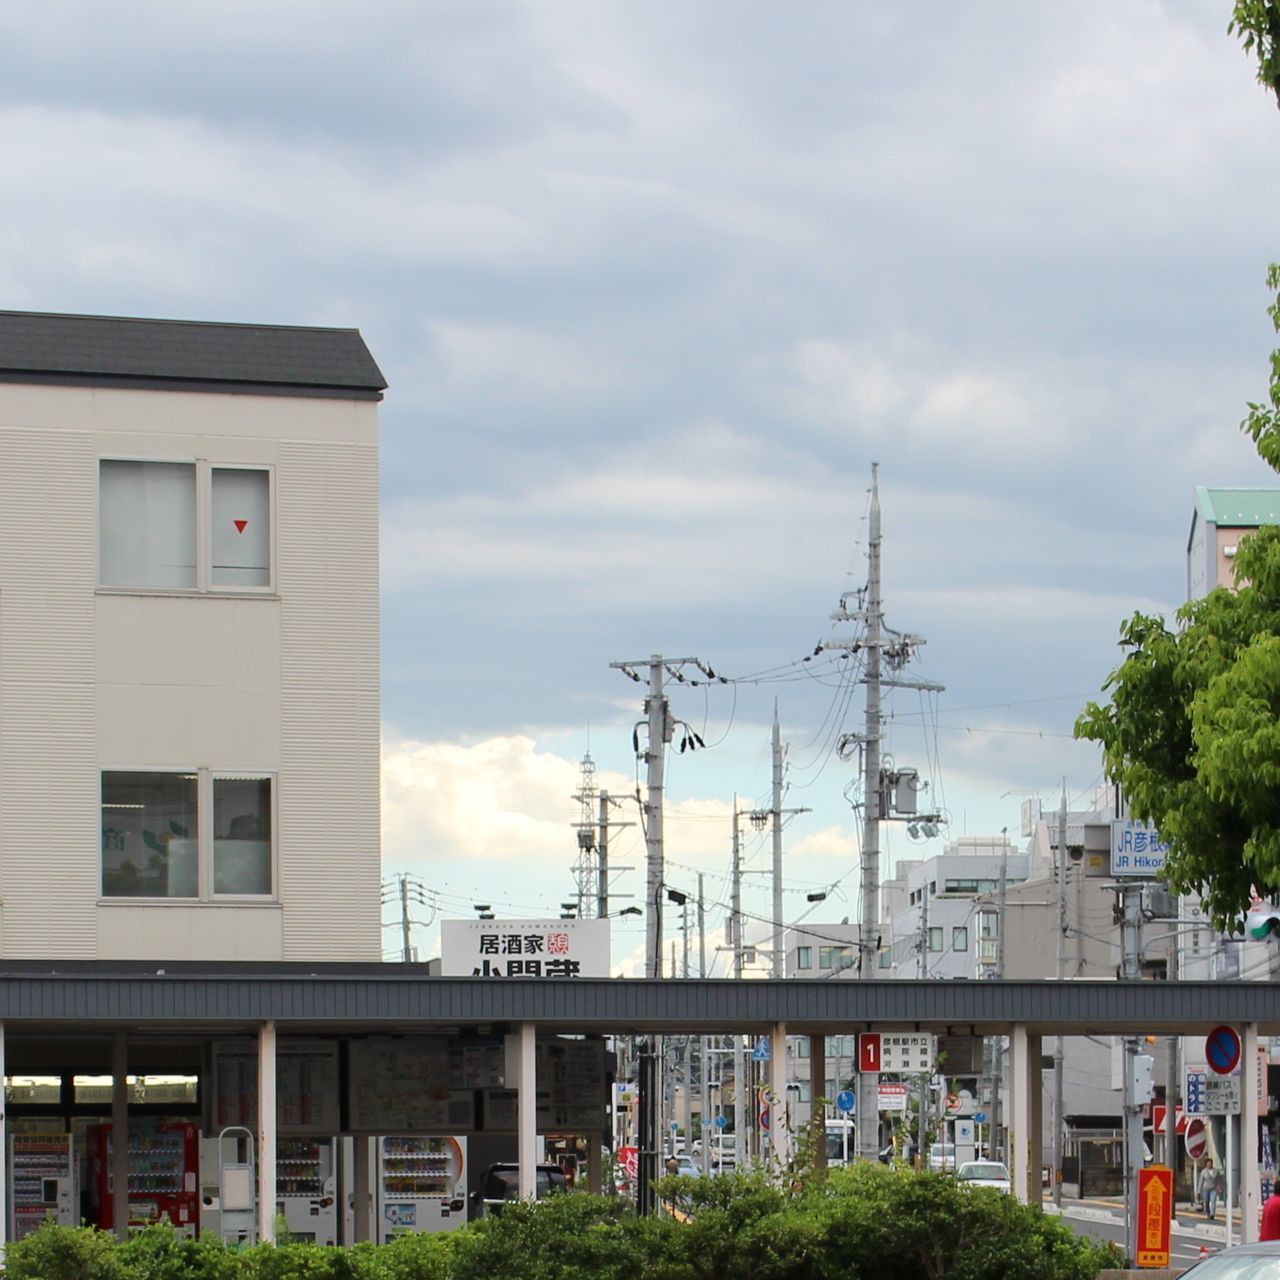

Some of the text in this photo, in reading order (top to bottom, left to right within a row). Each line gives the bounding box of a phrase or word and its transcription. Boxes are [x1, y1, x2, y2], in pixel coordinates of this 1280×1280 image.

[1117, 830, 1169, 853] JR彦根
[1115, 855, 1129, 868] JR
[479, 933, 545, 955] 居酒家
[883, 1037, 928, 1046] 彦根駅市立
[866, 1043, 875, 1064] 1
